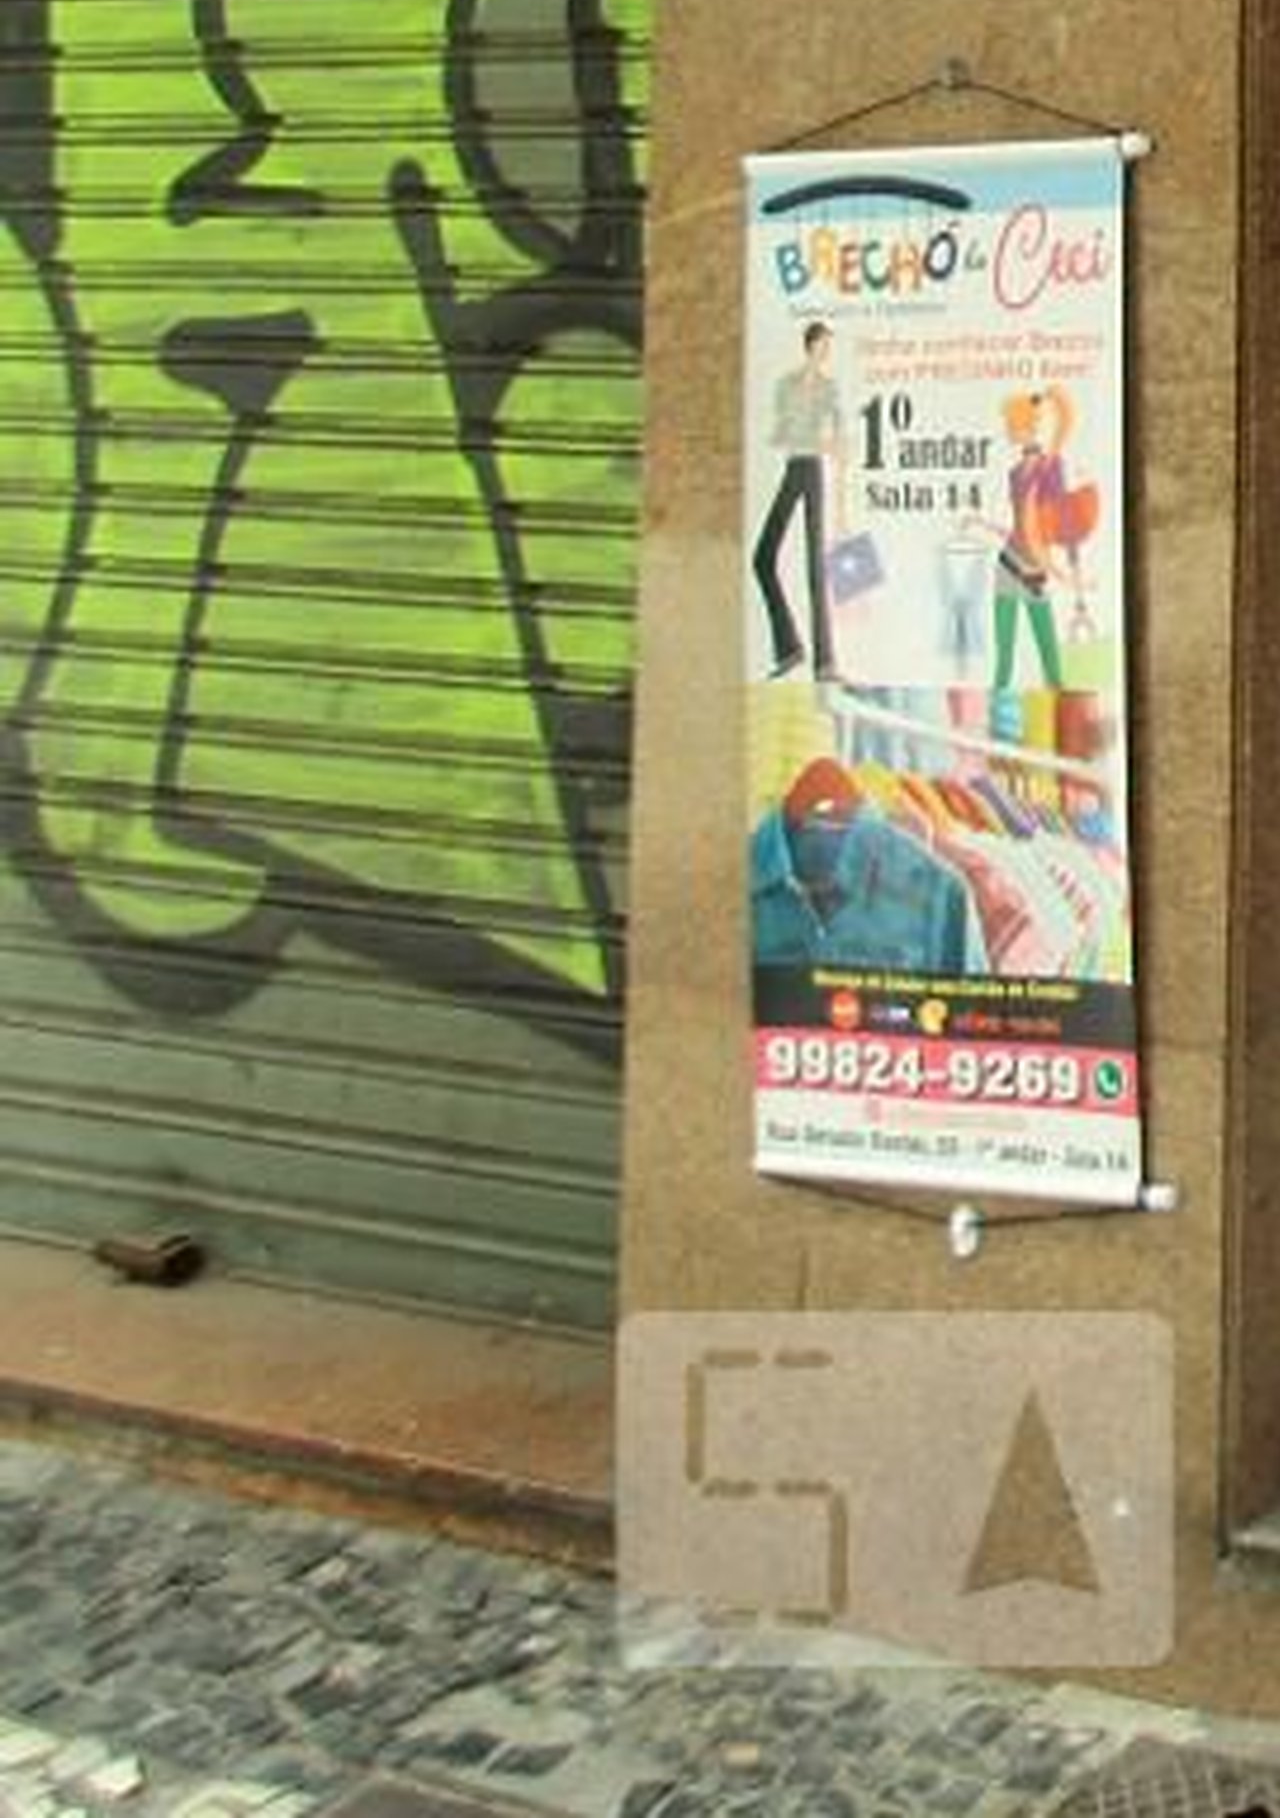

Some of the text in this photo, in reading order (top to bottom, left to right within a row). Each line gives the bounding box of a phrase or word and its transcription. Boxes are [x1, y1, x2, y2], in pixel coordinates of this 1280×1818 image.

[775, 221, 959, 294] BRECHÓ
[898, 435, 992, 471] andar
[865, 482, 934, 512] Sala
[764, 1034, 1081, 1103] 99824-9269
